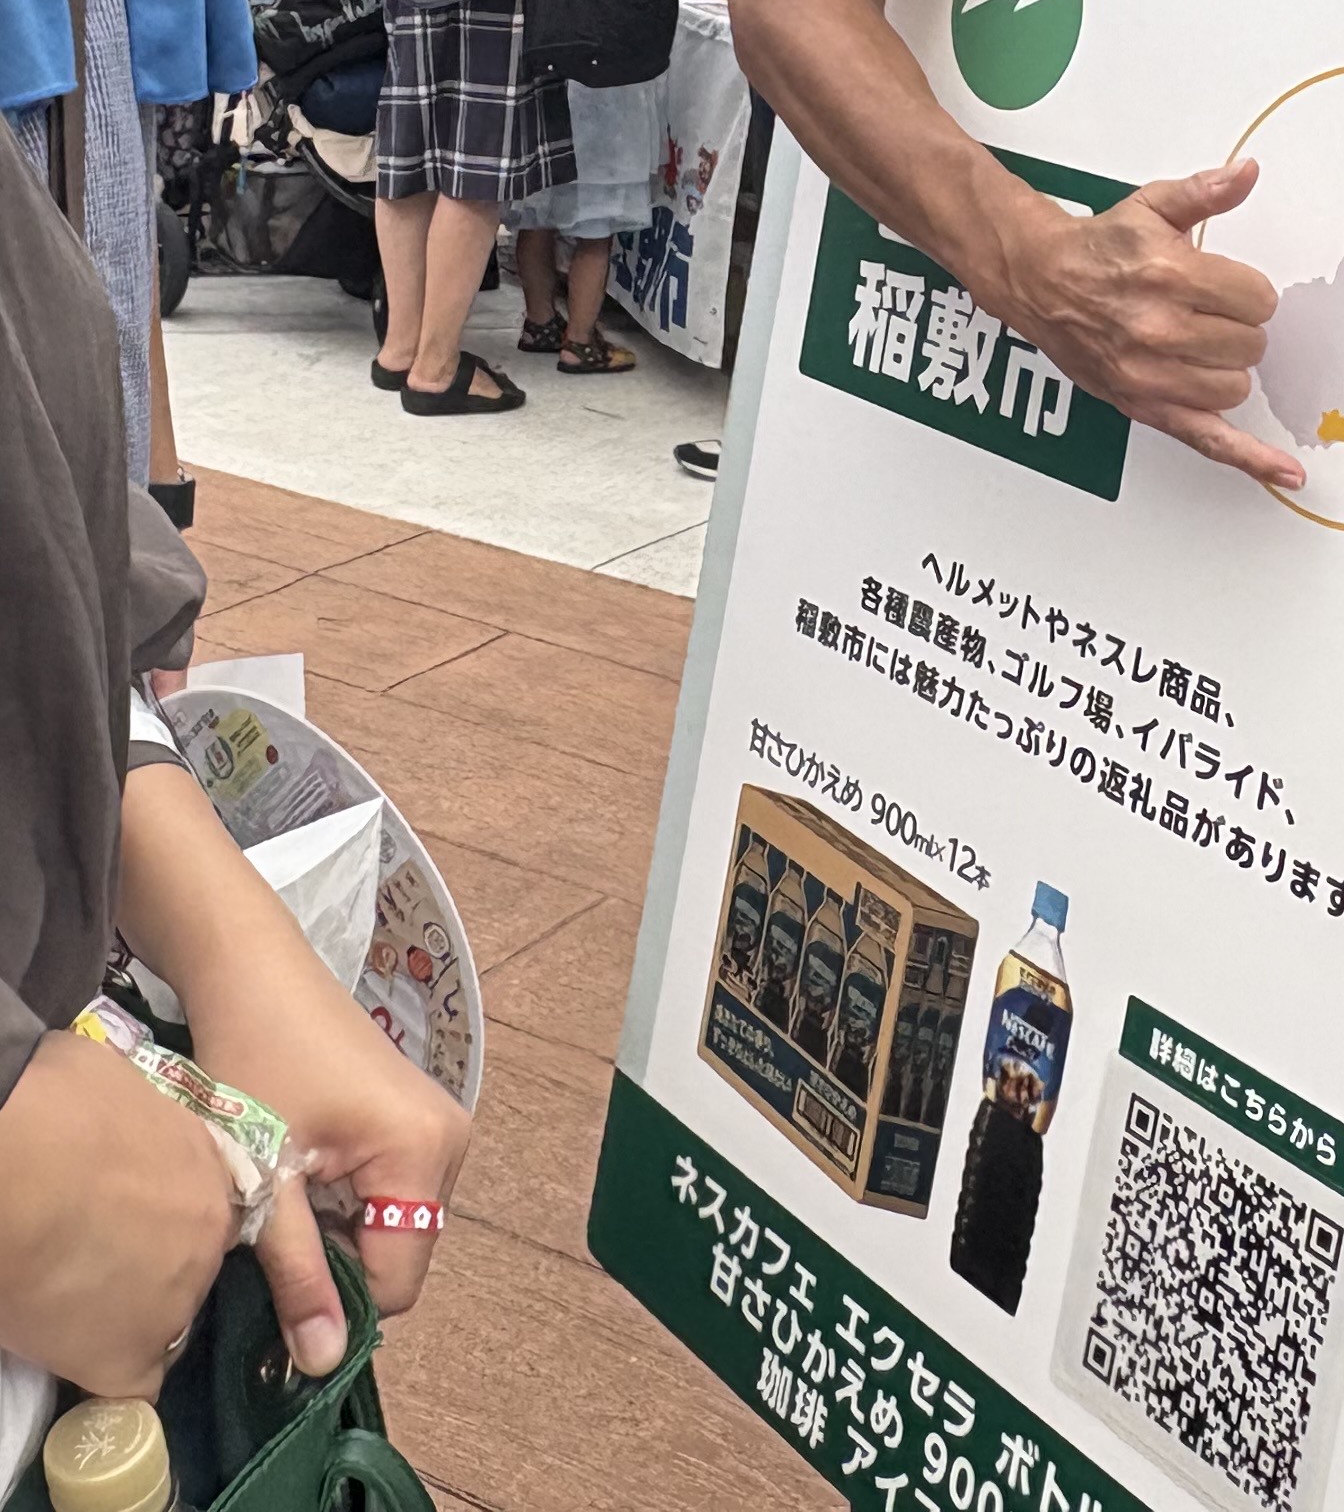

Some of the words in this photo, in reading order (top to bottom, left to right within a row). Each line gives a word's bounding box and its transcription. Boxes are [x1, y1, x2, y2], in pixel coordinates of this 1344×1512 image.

[847, 258, 1076, 438] 稲敷市
[860, 575, 1298, 827] 各種農産物、ゴルフ場、イバライド、
[920, 550, 1240, 729] ヘルメットやネスレ商品、
[748, 717, 864, 813] 甘さひかえめ
[1150, 1026, 1339, 1167] 詳細はこちらから
[670, 1154, 818, 1312] ネスカフェ
[835, 1297, 977, 1437] エクセラ
[994, 1431, 1103, 1512] ボト
[708, 1251, 904, 1449] 甘さひかえめ
[755, 1348, 830, 1450] 珈琲
